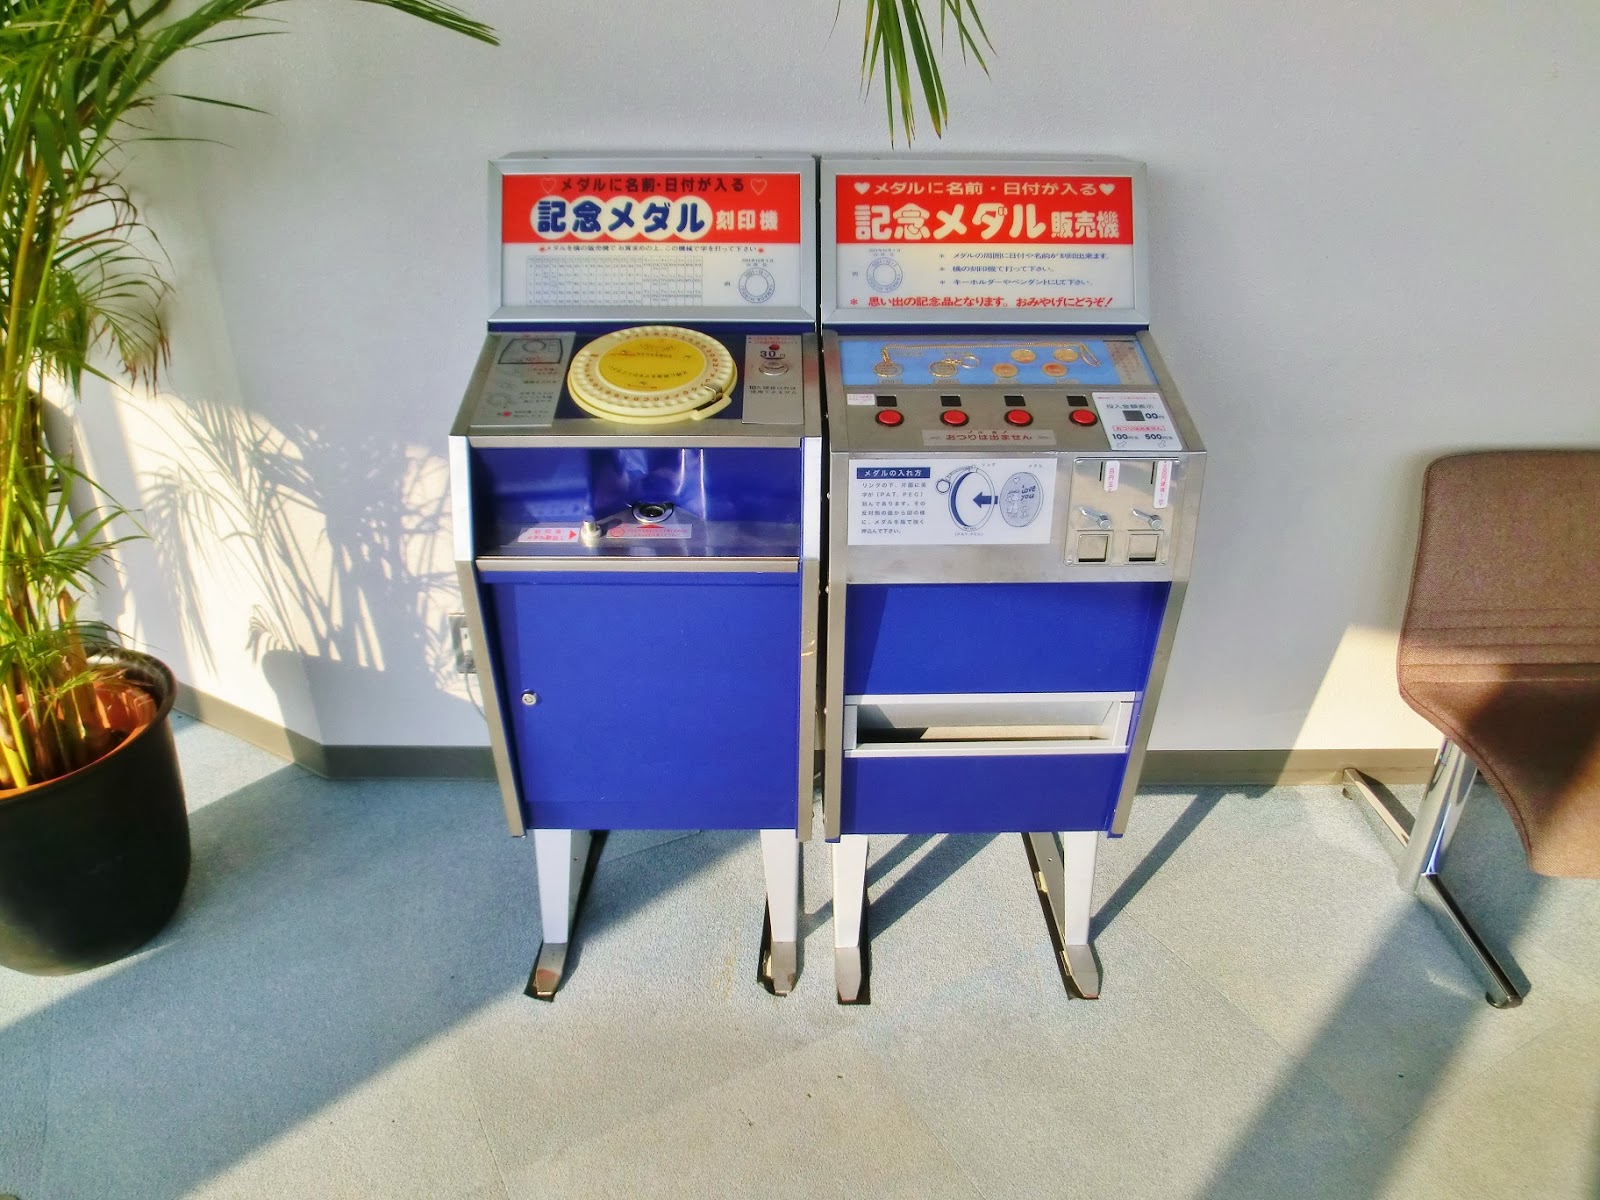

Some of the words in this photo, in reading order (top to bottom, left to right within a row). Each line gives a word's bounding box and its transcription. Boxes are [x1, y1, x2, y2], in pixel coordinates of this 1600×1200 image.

[561, 177, 744, 193] メダルに名前・日付が入る
[873, 181, 1098, 196] メダルに名前・日付が入る
[538, 200, 705, 233] 記念メダル
[716, 209, 779, 231] 刻印機
[854, 202, 1047, 240] 記念メダル
[1051, 210, 1120, 239] 販売機
[868, 296, 1008, 307] 思い出の記念品となります。
[864, 469, 923, 477] メダルの入れ方
